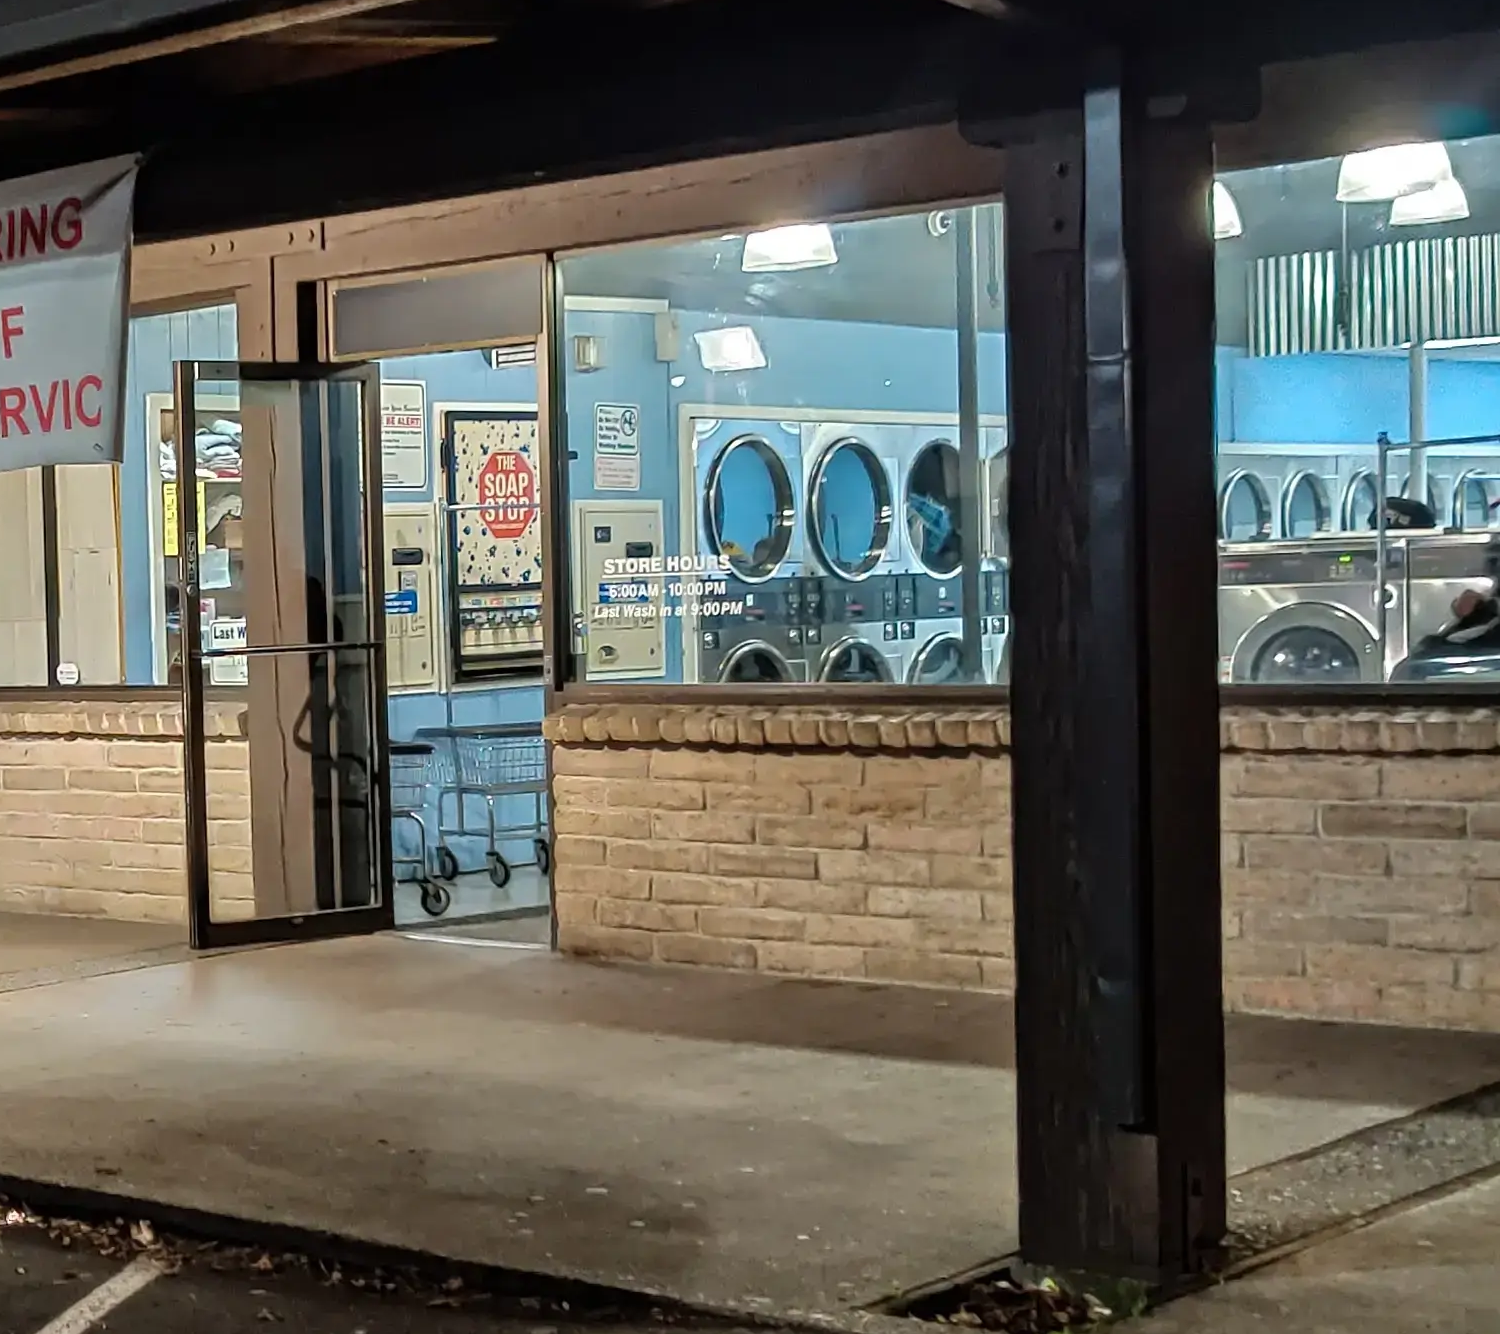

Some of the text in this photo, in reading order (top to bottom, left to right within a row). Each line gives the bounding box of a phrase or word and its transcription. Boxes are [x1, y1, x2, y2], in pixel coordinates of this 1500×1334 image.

[496, 454, 516, 471] THE
[484, 472, 529, 497] SOAP
[485, 496, 530, 522] STOP
[603, 554, 731, 574] STORE HOURS
[668, 581, 726, 597] 10:00PM
[594, 601, 744, 618] Last Wash in at 9:00PM
[214, 626, 235, 639] Last
